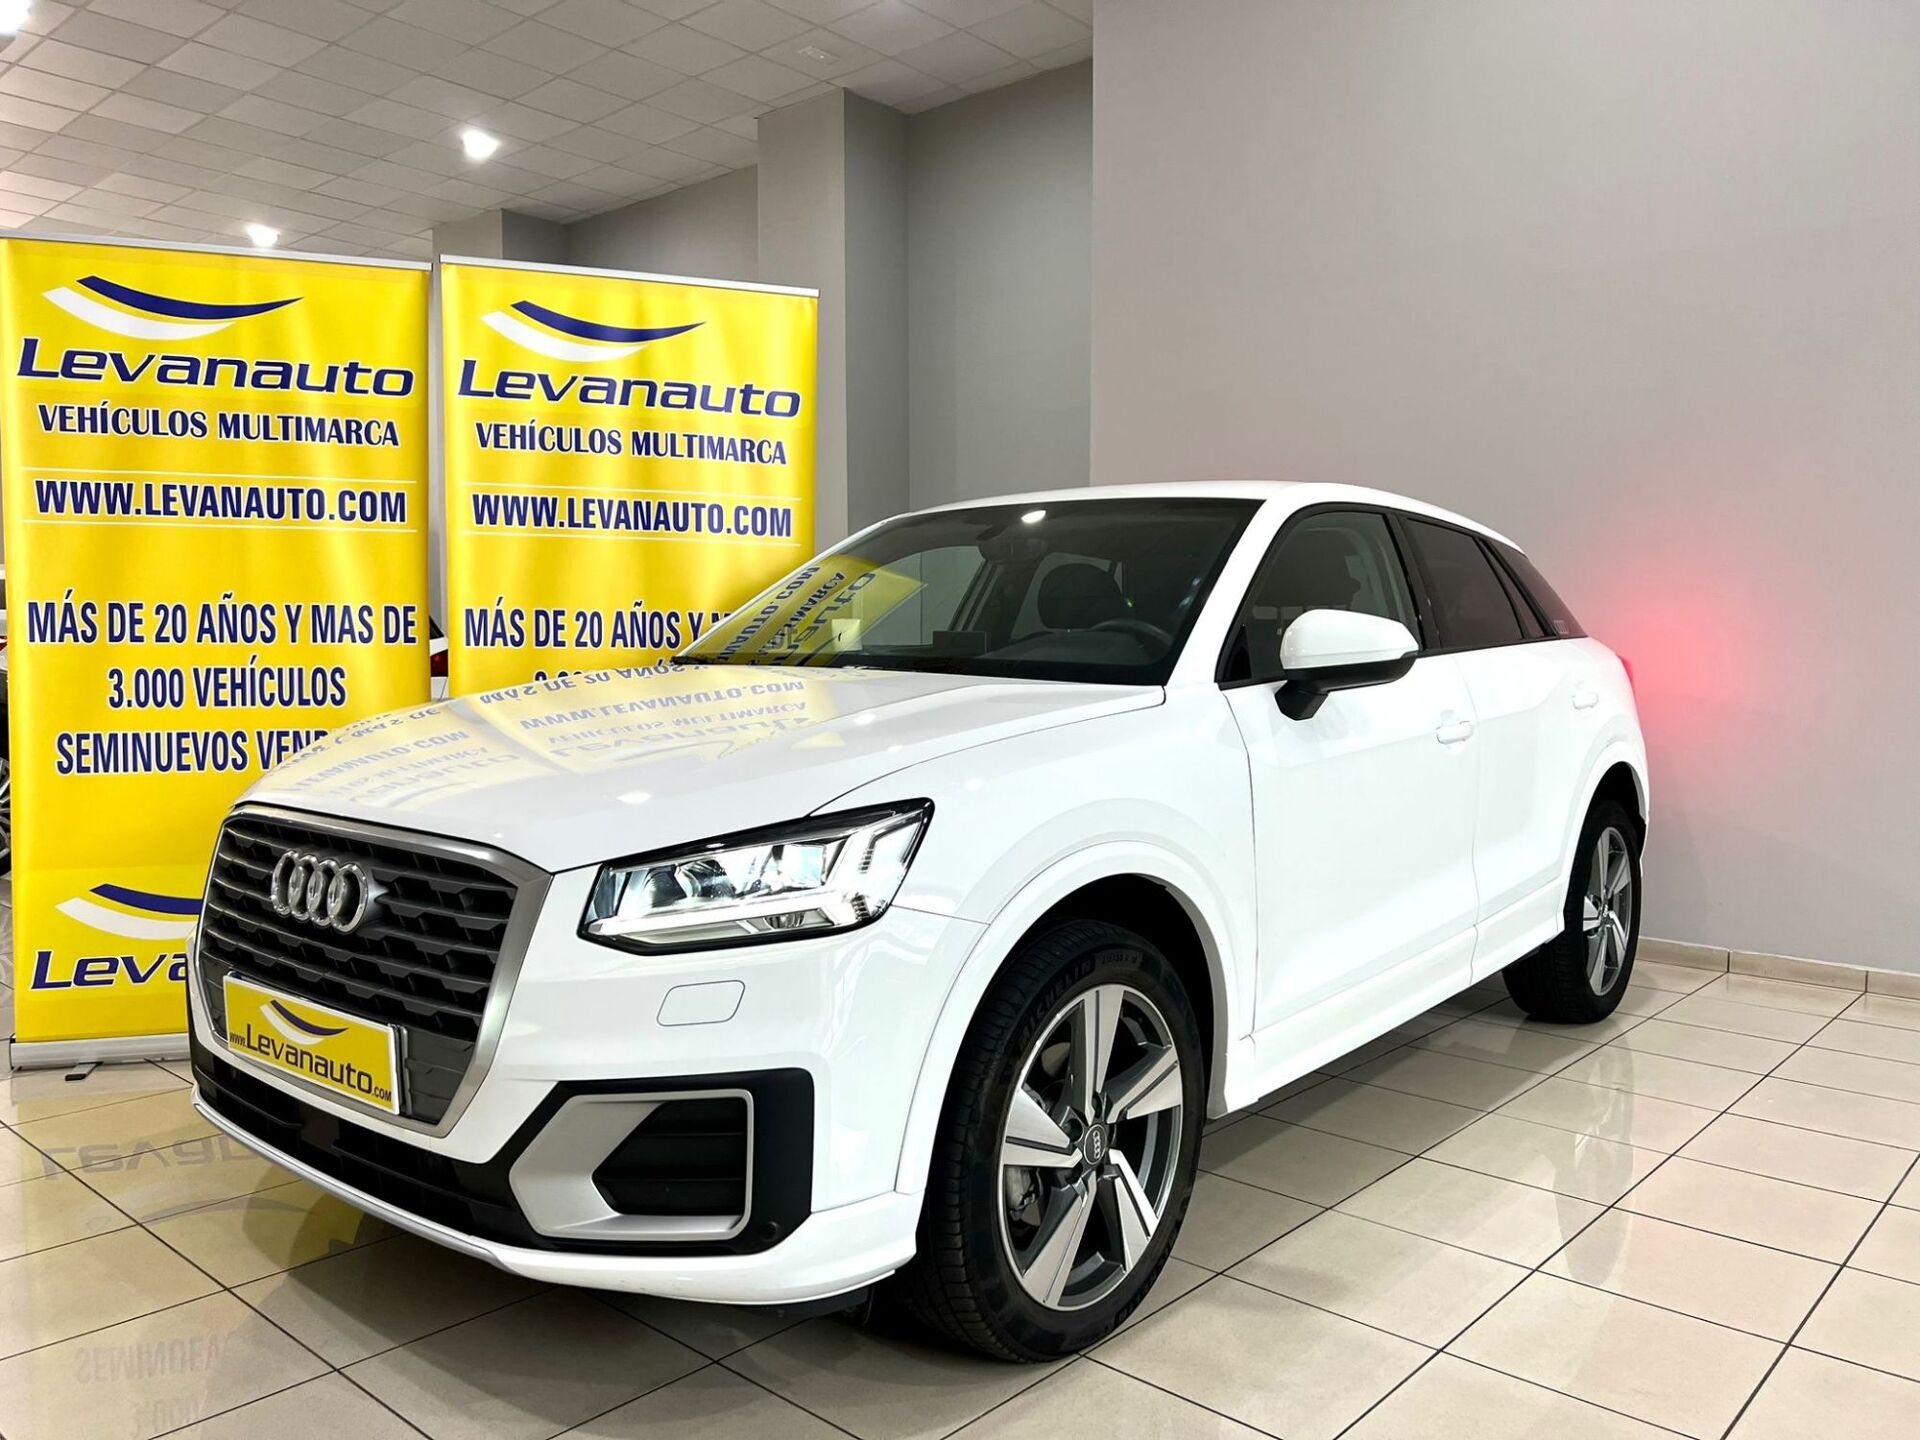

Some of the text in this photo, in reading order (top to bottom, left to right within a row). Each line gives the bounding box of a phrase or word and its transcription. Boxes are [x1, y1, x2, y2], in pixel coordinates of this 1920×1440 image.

[17, 337, 414, 396] Levanauto
[458, 359, 801, 418] Levanauto
[38, 401, 400, 446] VEHÍCULOS MULTIMARCA
[475, 420, 787, 465] VEHÍCULOS MULTIMARCA
[35, 480, 406, 523] WWW.LEVANAUTO.COM
[472, 494, 792, 537] WWW.LEVANAUTO.COM
[28, 589, 417, 644] MÁS DE 20 AÑOS Y MAS DE
[465, 596, 704, 649] MÁS DE 20 AÑOS Y
[108, 655, 346, 708] 3.000 VEHÍCULOS
[56, 730, 248, 774] SEMINUEVOS
